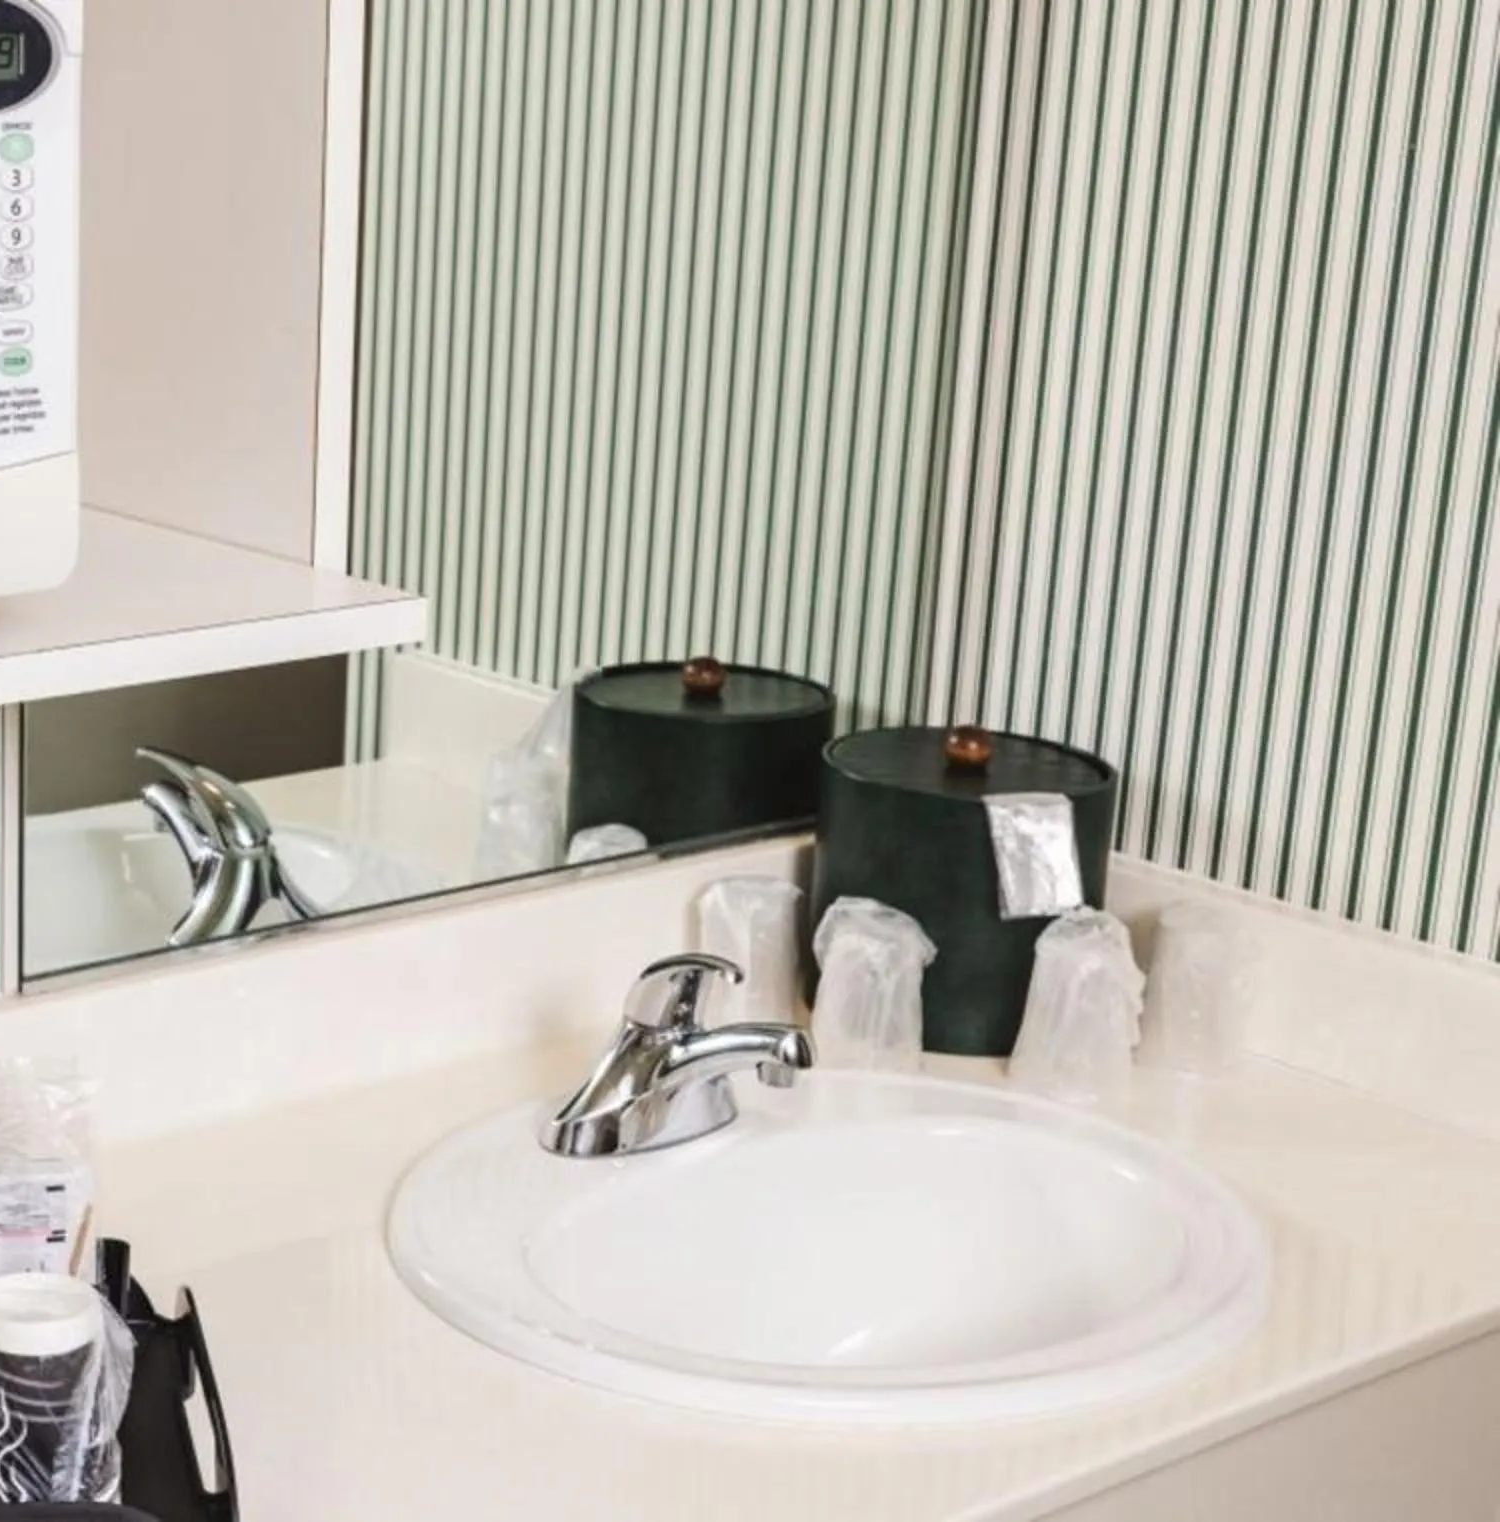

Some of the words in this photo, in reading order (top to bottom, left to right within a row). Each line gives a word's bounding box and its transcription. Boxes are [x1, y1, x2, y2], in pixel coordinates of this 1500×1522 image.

[11, 168, 21, 187] 3
[10, 198, 21, 216] 6
[11, 227, 21, 246] 9
